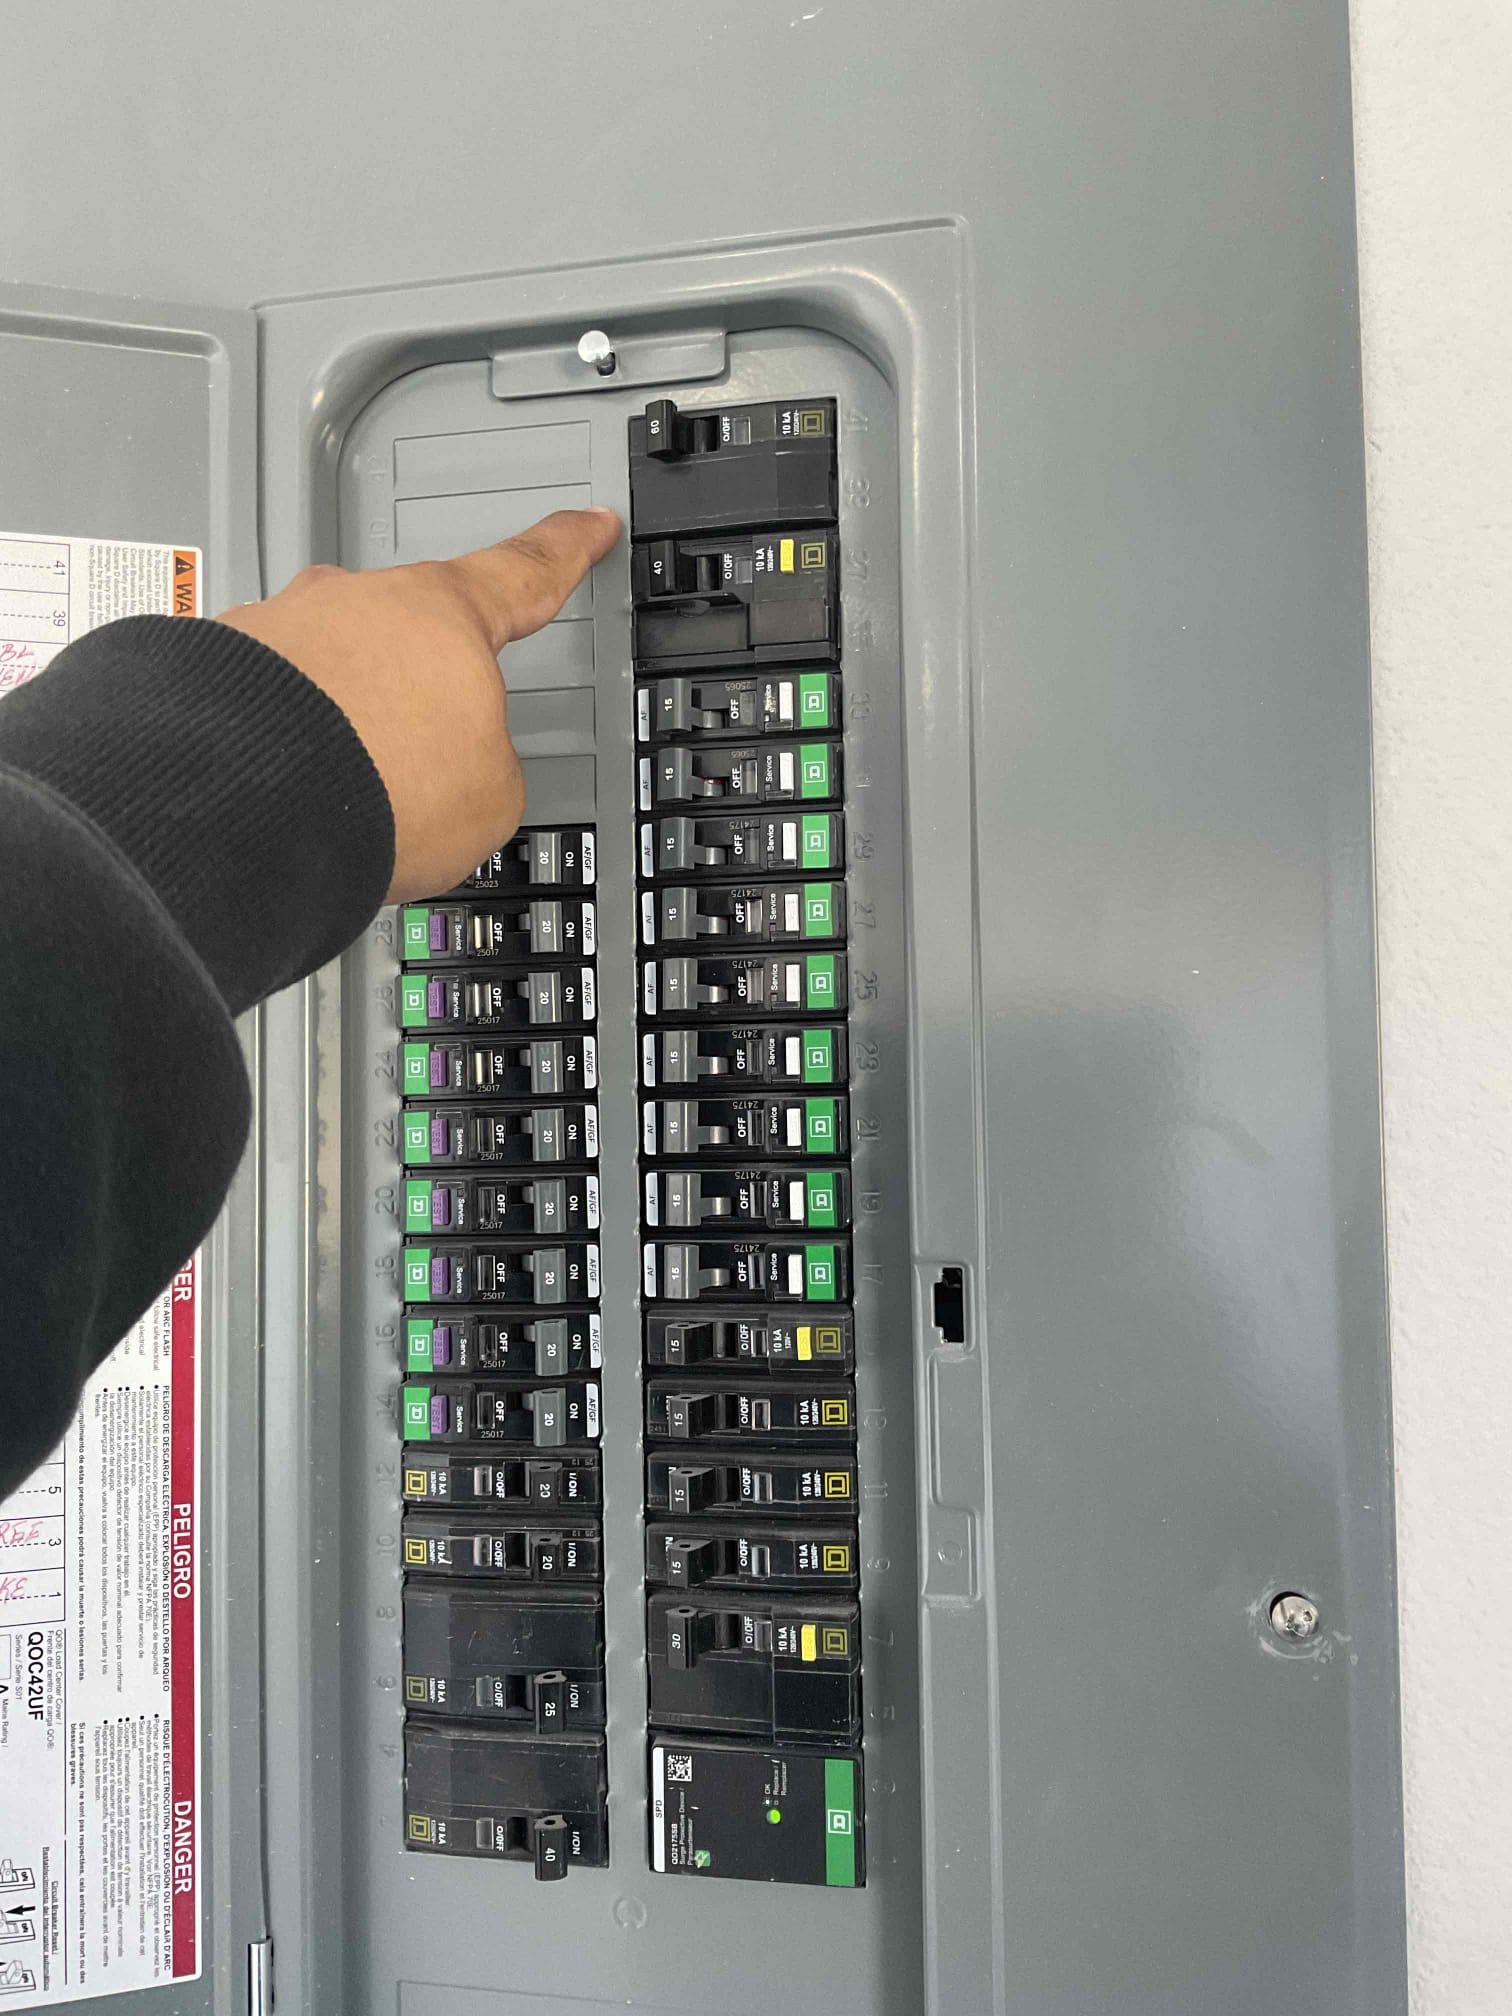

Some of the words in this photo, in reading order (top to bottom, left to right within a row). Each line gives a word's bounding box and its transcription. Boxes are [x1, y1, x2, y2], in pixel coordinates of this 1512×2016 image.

[651, 419, 660, 435] 60
[723, 416, 731, 442] O/OFF
[782, 424, 791, 435] 10
[54, 561, 65, 577] 41
[654, 560, 663, 576] 40
[725, 553, 734, 581] O/OFF
[756, 561, 765, 571] 10
[54, 610, 66, 627] 39
[665, 699, 673, 712] 15
[731, 699, 739, 720] OFF
[666, 768, 674, 781] 15
[732, 767, 740, 788] OFF
[643, 845, 652, 858] AF
[667, 838, 675, 851] 15
[734, 835, 743, 855] OFF
[539, 852, 548, 864] 20
[566, 851, 573, 867] ON
[585, 846, 594, 871] AF/GF
[475, 880, 499, 889] 25023
[670, 907, 678, 921] 15
[494, 922, 502, 943] OFF
[542, 921, 551, 933] 20
[566, 922, 574, 938] ON
[476, 948, 498, 956] 25017
[732, 960, 758, 969] 24175
[646, 979, 655, 994] AF
[671, 977, 679, 992] 15
[738, 976, 746, 996] OFF
[853, 971, 880, 1001] 25
[493, 987, 501, 1008] OFF
[565, 987, 573, 1003] ON
[585, 983, 593, 1007] AF/GF
[732, 1030, 759, 1039] 24175
[494, 1055, 502, 1076] OFF
[567, 1056, 575, 1072] ON
[645, 1056, 654, 1070] AF
[671, 1051, 679, 1065] 15
[737, 1049, 745, 1069] OFF
[541, 1060, 550, 1073] 20
[732, 1101, 759, 1110] 24175
[568, 1124, 576, 1141] ON
[588, 1119, 596, 1143] AF/GF
[646, 1121, 654, 1135] AF
[671, 1121, 679, 1135] 15
[738, 1117, 746, 1137] OFF
[543, 1130, 552, 1143] 20
[481, 1153, 503, 1161] 25017
[497, 1194, 505, 1215] OFF
[569, 1195, 578, 1211] ON
[588, 1189, 597, 1215] AF/GF
[648, 1192, 657, 1206] AF
[674, 1193, 682, 1207] 15
[740, 1188, 749, 1209] OFF
[545, 1203, 554, 1216] 20
[497, 1262, 505, 1283] OFF
[570, 1264, 578, 1280] ON
[673, 1266, 681, 1280] 15
[739, 1261, 747, 1282] OFF
[771, 1254, 779, 1281] Service
[545, 1271, 554, 1284] 20
[163, 1296, 170, 1307] OR
[483, 1292, 505, 1300] 25017
[500, 1332, 508, 1353] OFF
[741, 1325, 750, 1351] O/OFF
[774, 1339, 781, 1352] 10
[547, 1344, 556, 1357] 20
[672, 1339, 680, 1353] 15
[496, 1401, 504, 1422] OFF
[570, 1403, 578, 1420] ON
[741, 1396, 750, 1424] O/OFF
[545, 1413, 553, 1426] 20
[675, 1412, 683, 1426] 15
[163, 1424, 170, 1434] DE
[481, 1431, 504, 1439] 25017
[48, 1486, 61, 1495] 5
[541, 1483, 550, 1497] 20
[675, 1488, 684, 1502] 15
[48, 1538, 62, 1546] 3
[173, 1502, 191, 1598] PELIGRO
[741, 1539, 750, 1567] O/OFF
[543, 1555, 552, 1569] 20
[673, 1561, 682, 1575] 15
[746, 1616, 755, 1643] O/OFF
[673, 1633, 682, 1649] 30
[28, 1631, 43, 1720] QOC42UF
[162, 1657, 170, 1691] ARQUEO
[47, 1694, 54, 1702] de
[545, 1702, 555, 1717] 25
[162, 1720, 170, 1750] RISQUE
[764, 1784, 770, 1794] OK
[175, 1800, 191, 1895] DANGER
[545, 1848, 554, 1862] 40
[163, 1892, 170, 1902] OU
